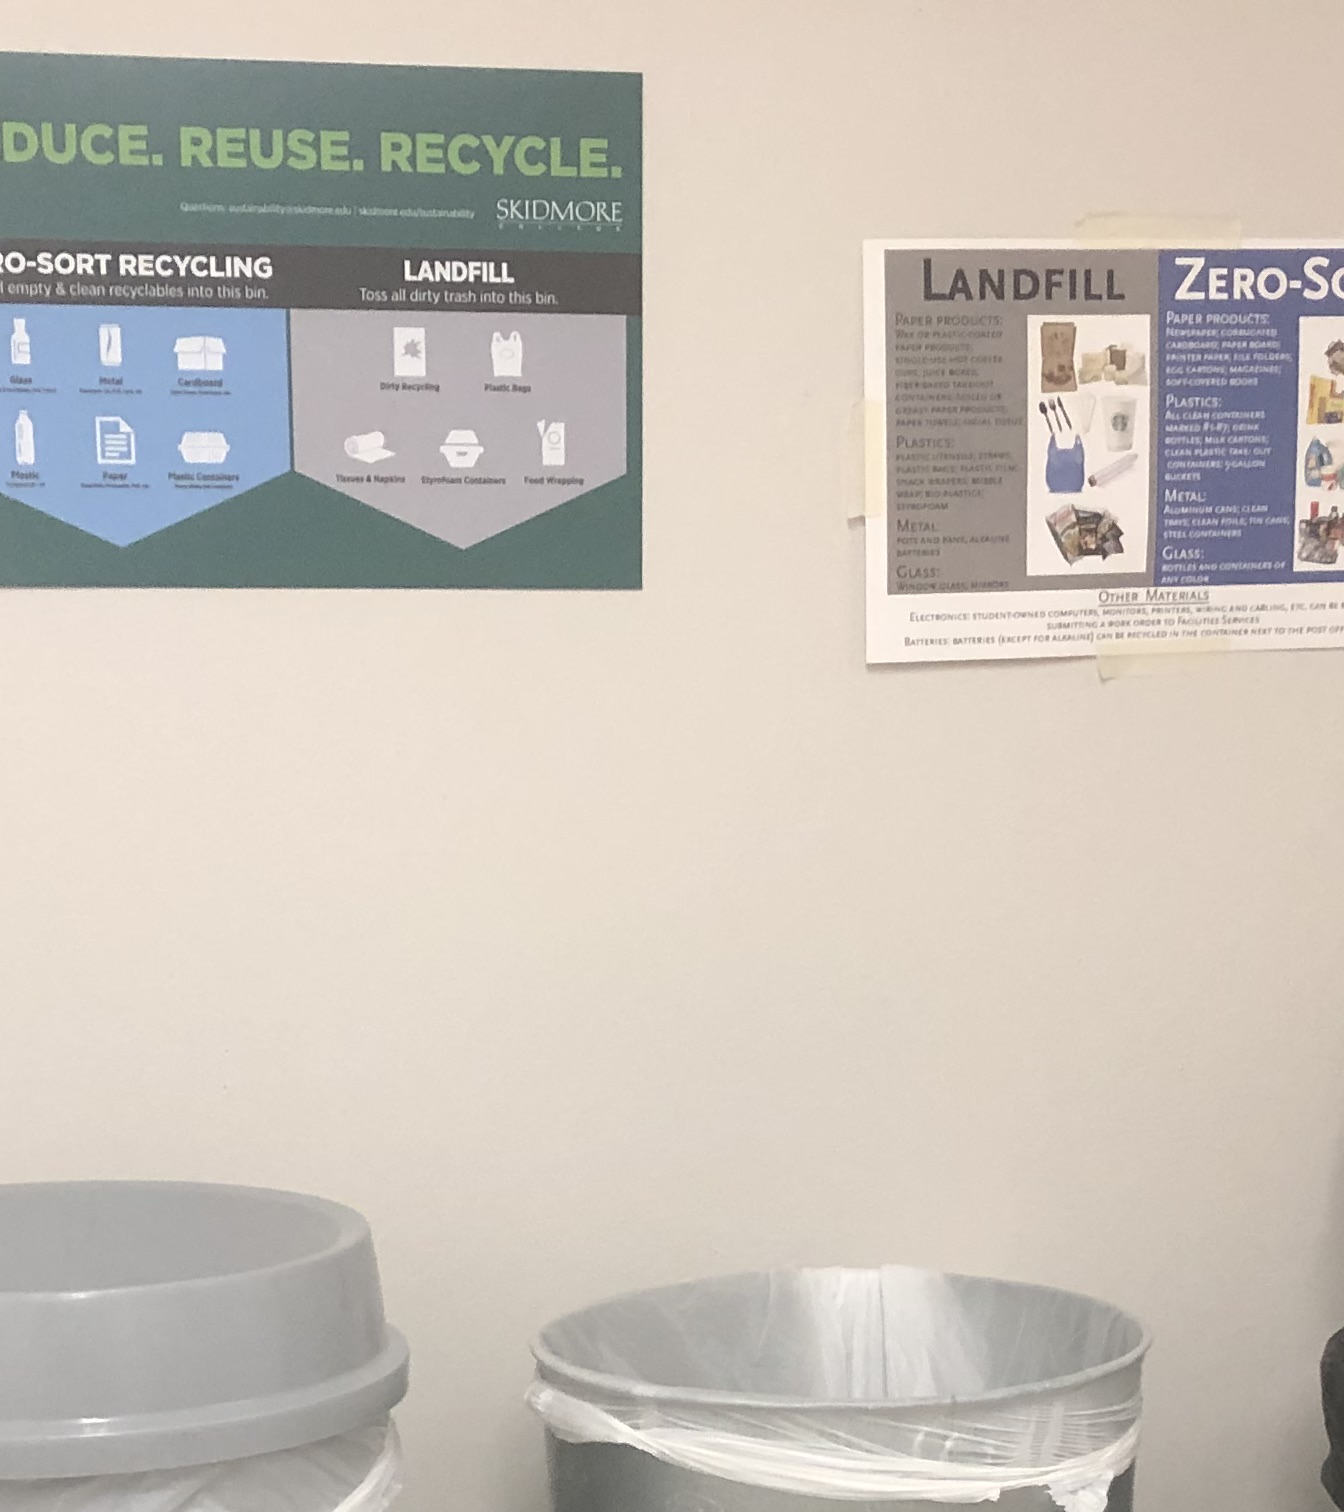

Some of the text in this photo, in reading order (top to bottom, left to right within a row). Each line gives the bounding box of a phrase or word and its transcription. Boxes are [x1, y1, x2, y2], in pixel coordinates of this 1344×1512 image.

[180, 127, 362, 170] REUSE.
[380, 133, 623, 177] RECYCLE.
[496, 198, 623, 223] SKIDMORE
[119, 255, 273, 278] RECYCLING
[404, 260, 514, 283] LANDFILL
[8, 284, 51, 296] empty
[56, 282, 65, 295] &
[70, 285, 106, 296] clean
[109, 284, 183, 297] recyclables
[187, 286, 213, 298] into
[217, 286, 241, 298] this
[245, 287, 270, 299] bin.
[923, 258, 1126, 301] LANDFILL
[359, 288, 387, 301] Toss
[391, 289, 406, 301] all
[410, 290, 440, 304] dirty
[444, 291, 476, 302] trash
[480, 292, 505, 303] into
[508, 292, 532, 304] this
[1098, 589, 1210, 602] OTHER MATERIALS
